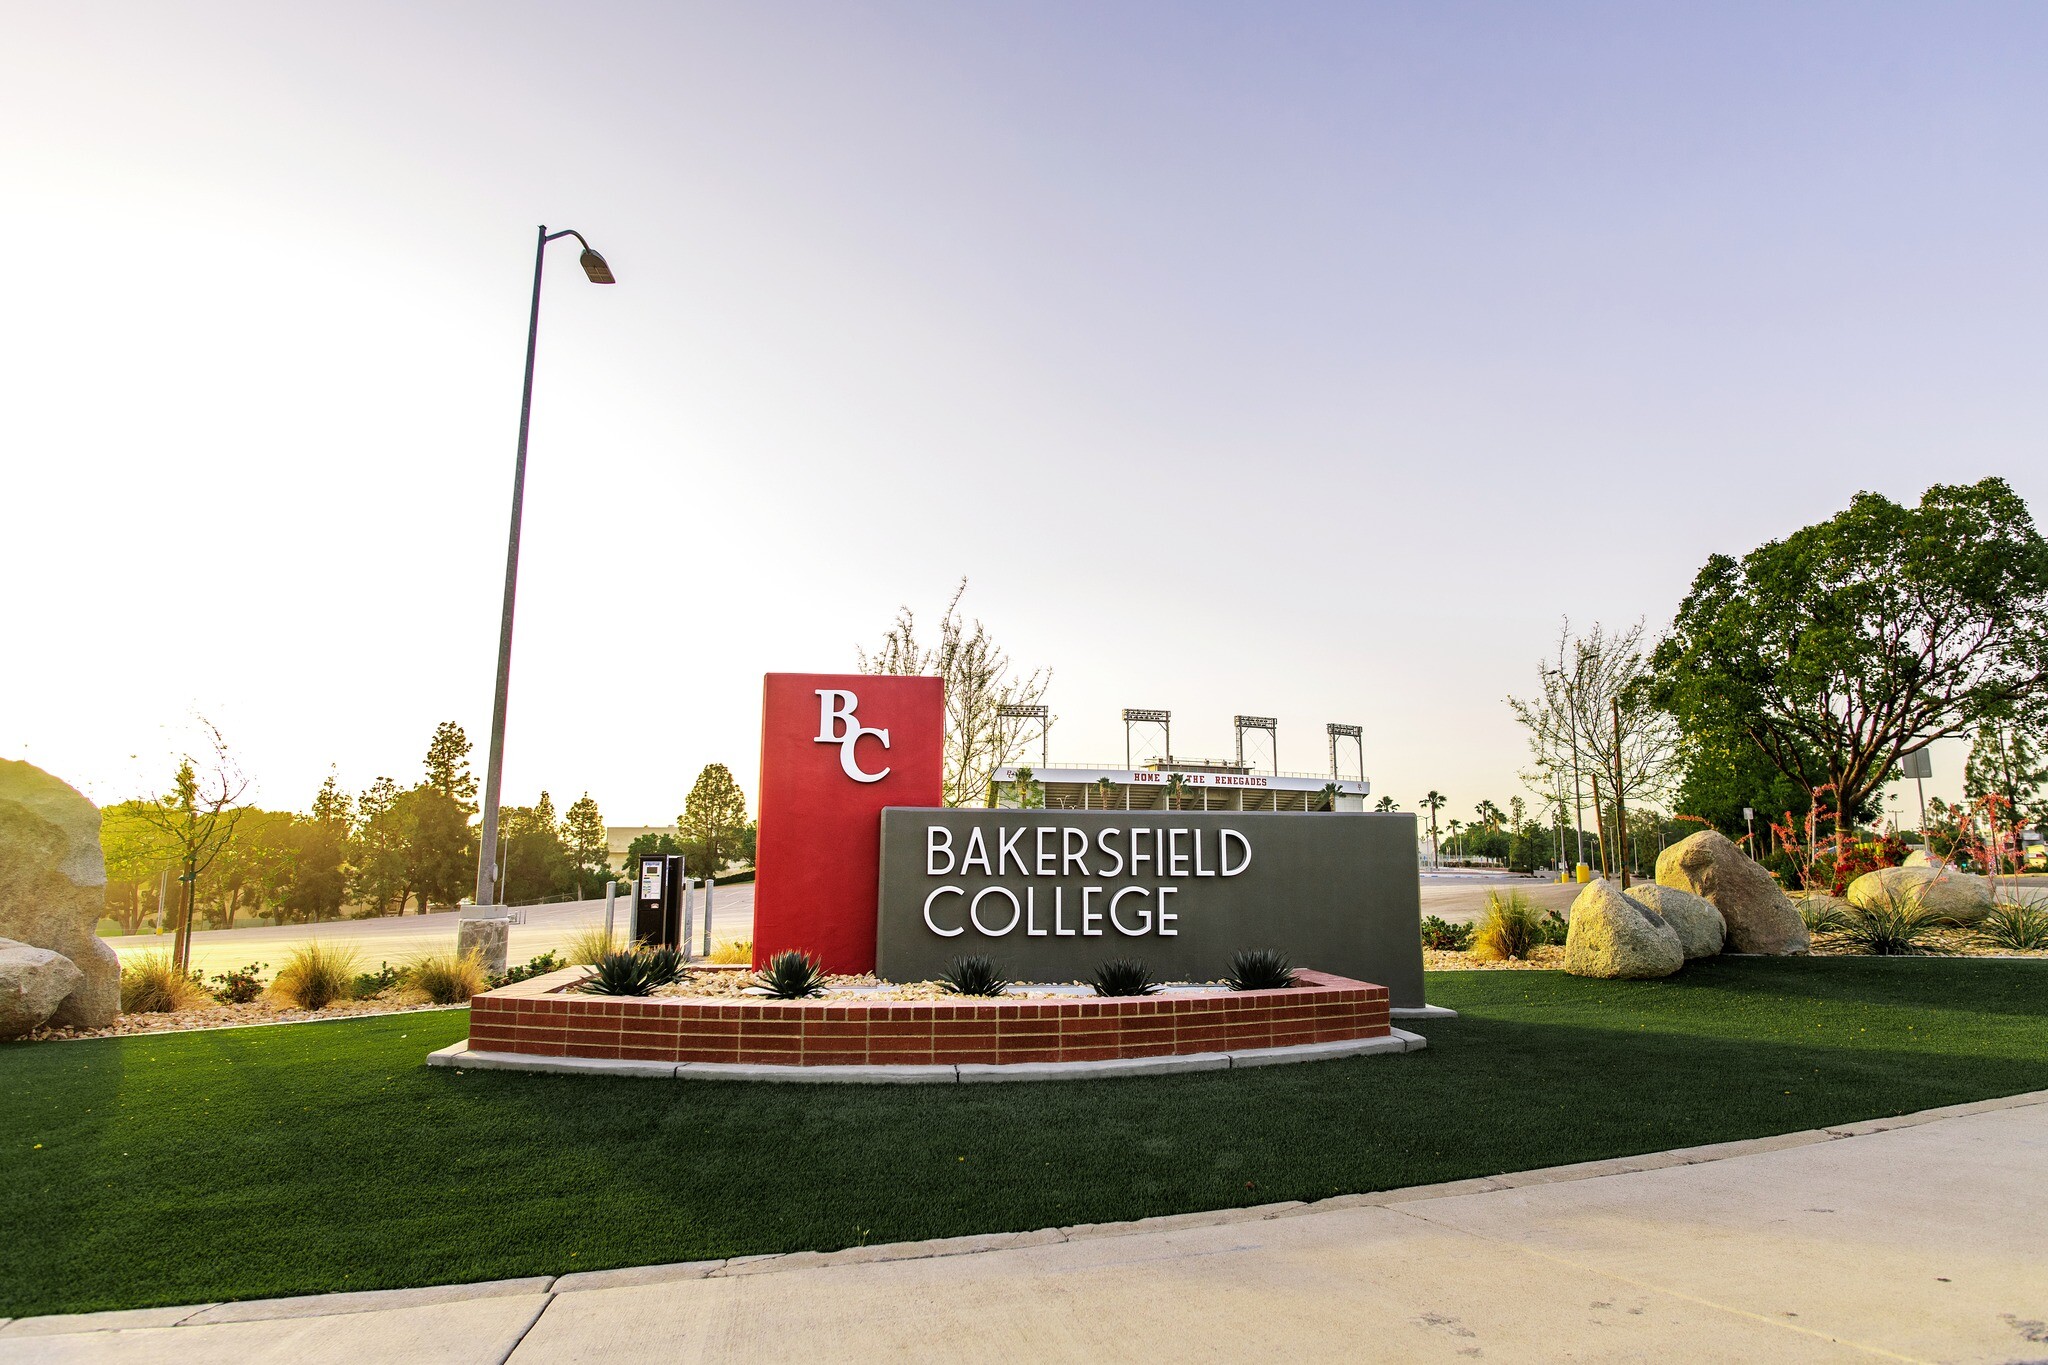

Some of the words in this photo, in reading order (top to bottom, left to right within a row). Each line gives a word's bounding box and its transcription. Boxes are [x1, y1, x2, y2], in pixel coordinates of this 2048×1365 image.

[814, 689, 891, 783] BC
[1134, 773, 1160, 782] HOME
[1186, 774, 1205, 783] THE
[1215, 776, 1267, 786] RENEGADES
[926, 826, 1252, 878] BAKERSFIELD
[923, 885, 1178, 937] COLLEGE
